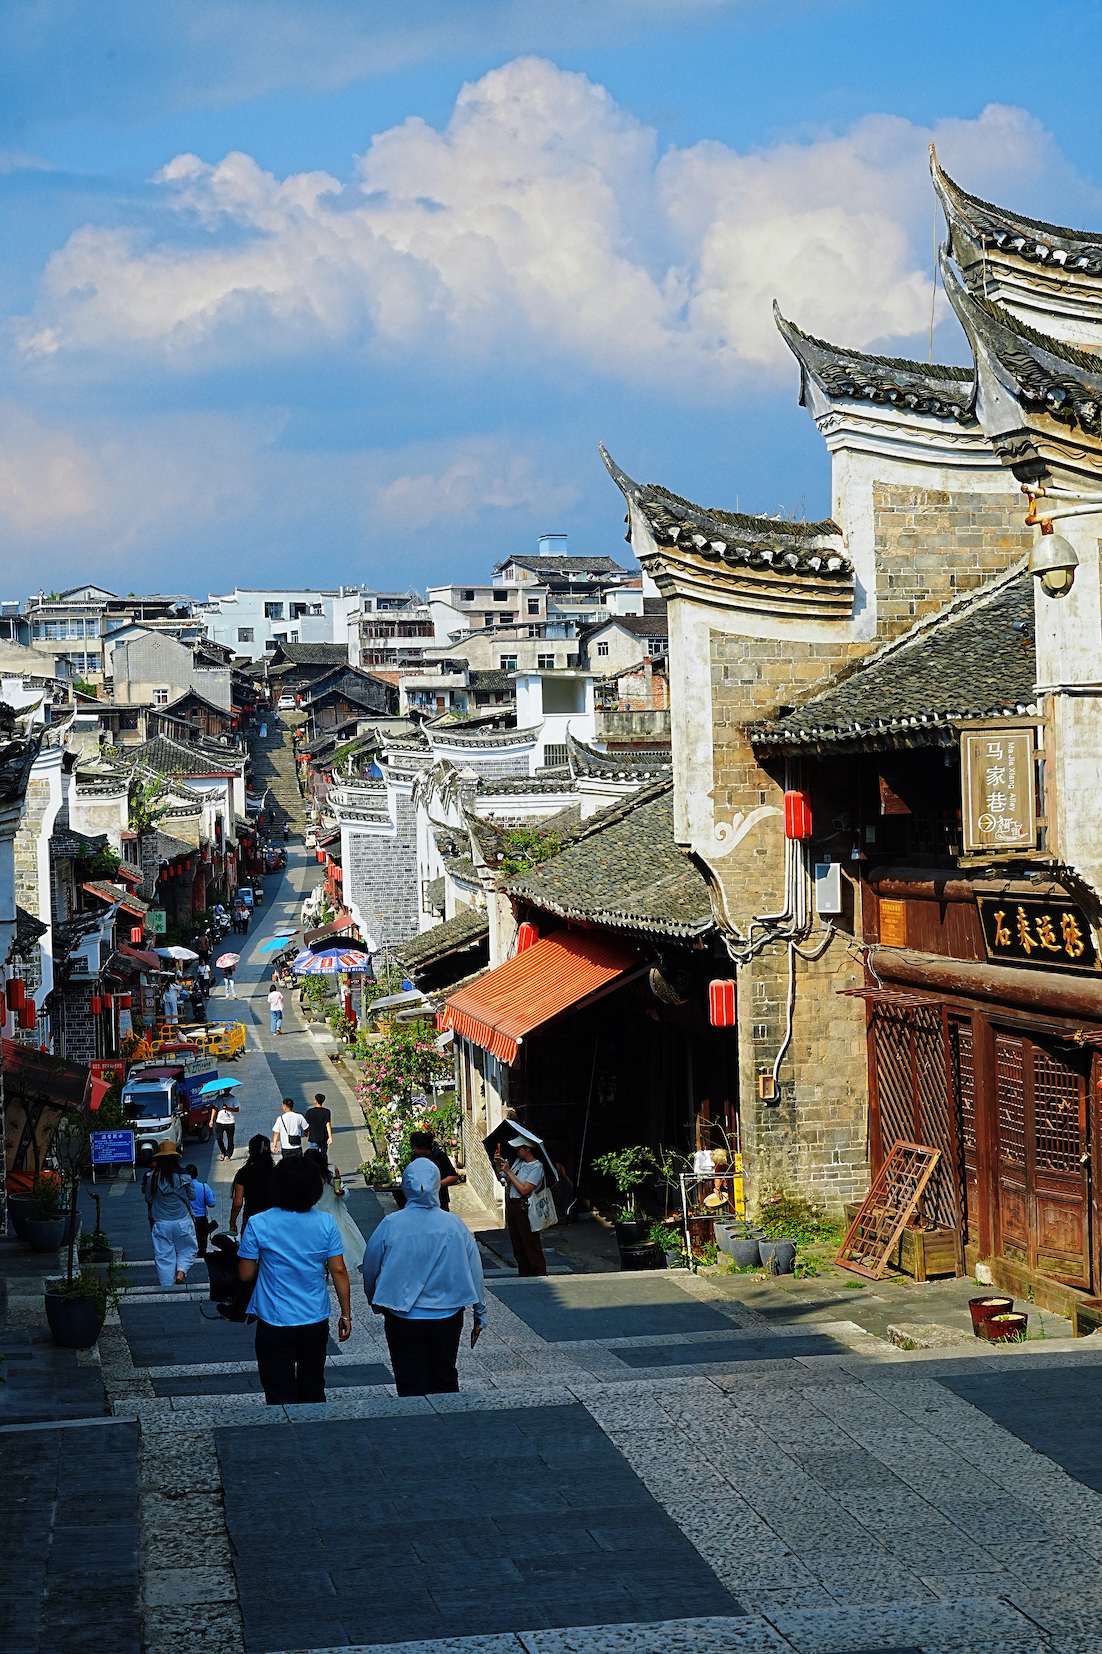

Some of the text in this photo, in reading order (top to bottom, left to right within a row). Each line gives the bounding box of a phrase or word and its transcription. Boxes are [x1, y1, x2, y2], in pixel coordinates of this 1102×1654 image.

[986, 742, 1007, 812] 马家巷
[1008, 767, 1016, 789] Xiang
[1009, 792, 1017, 812] Alley
